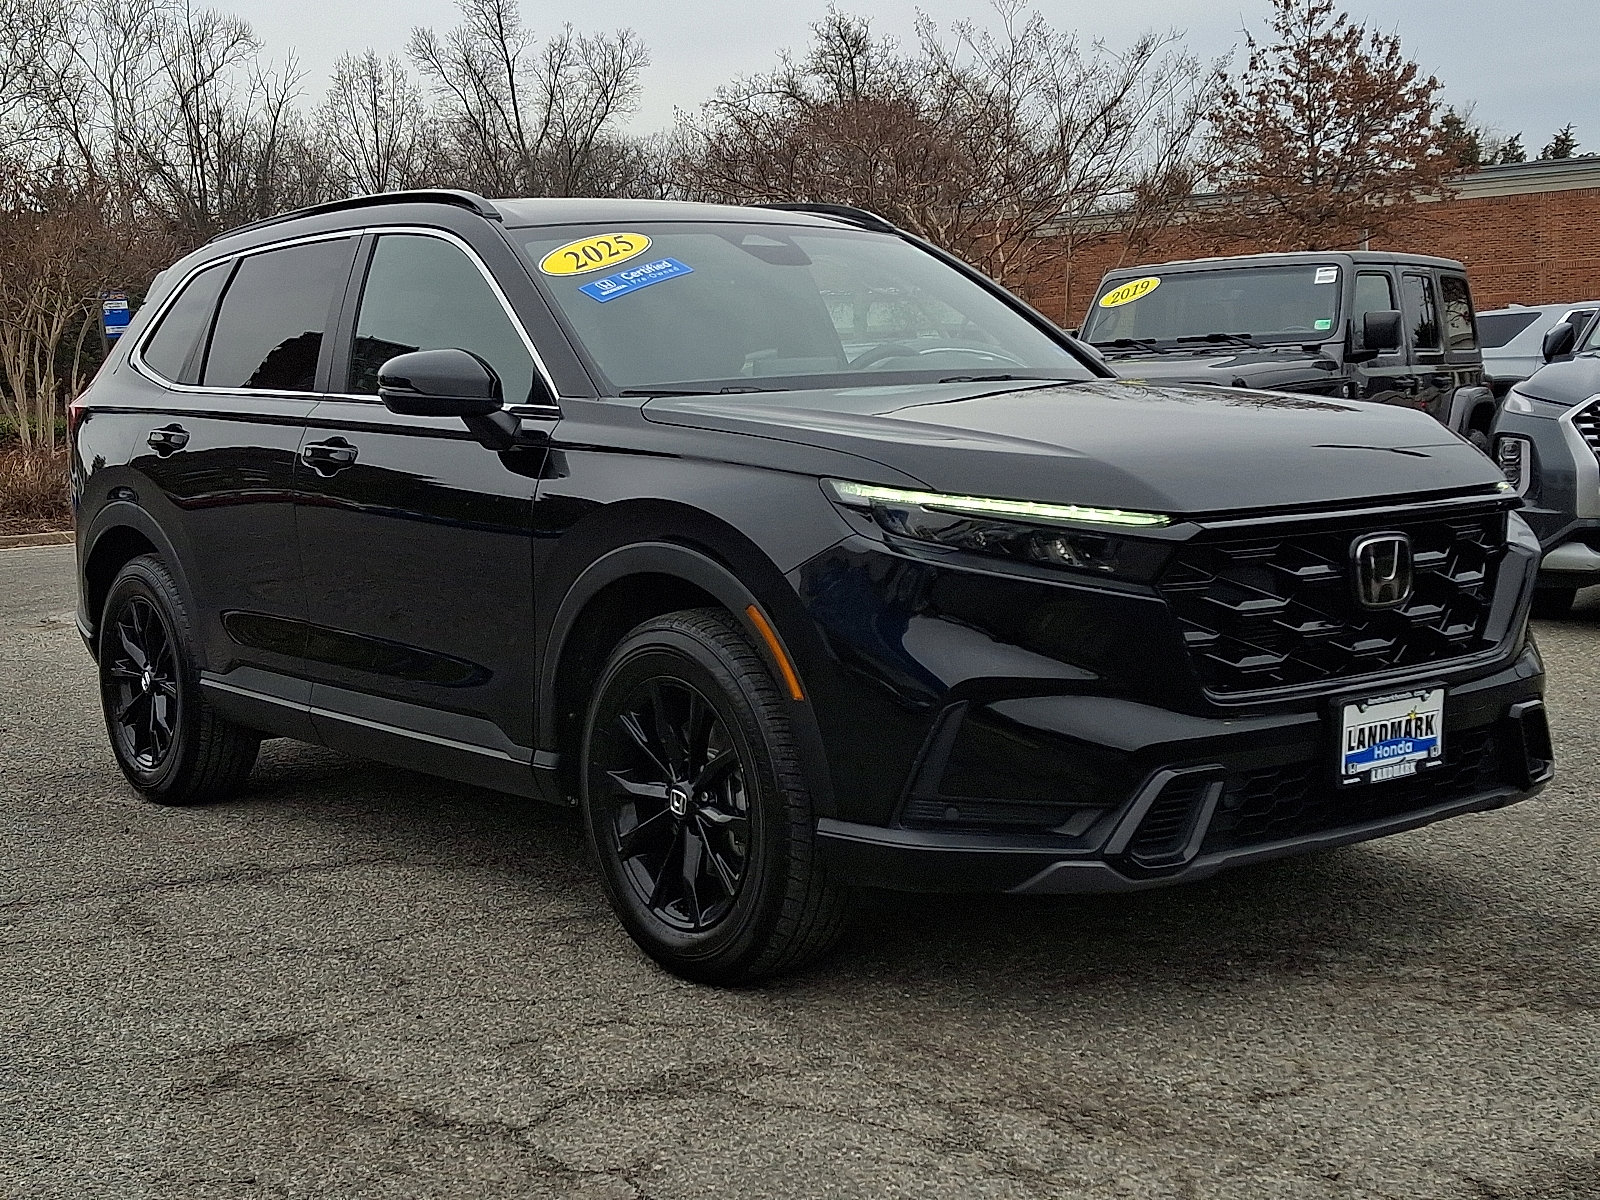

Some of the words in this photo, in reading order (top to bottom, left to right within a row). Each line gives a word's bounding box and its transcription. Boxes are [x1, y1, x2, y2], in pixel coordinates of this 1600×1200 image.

[564, 235, 633, 270] 2025
[621, 260, 672, 280] Certified
[1111, 281, 1150, 304] 2019
[1347, 714, 1435, 752] LANDMARK
[1374, 741, 1413, 759] Honda
[1371, 762, 1417, 782] LANDMARK
